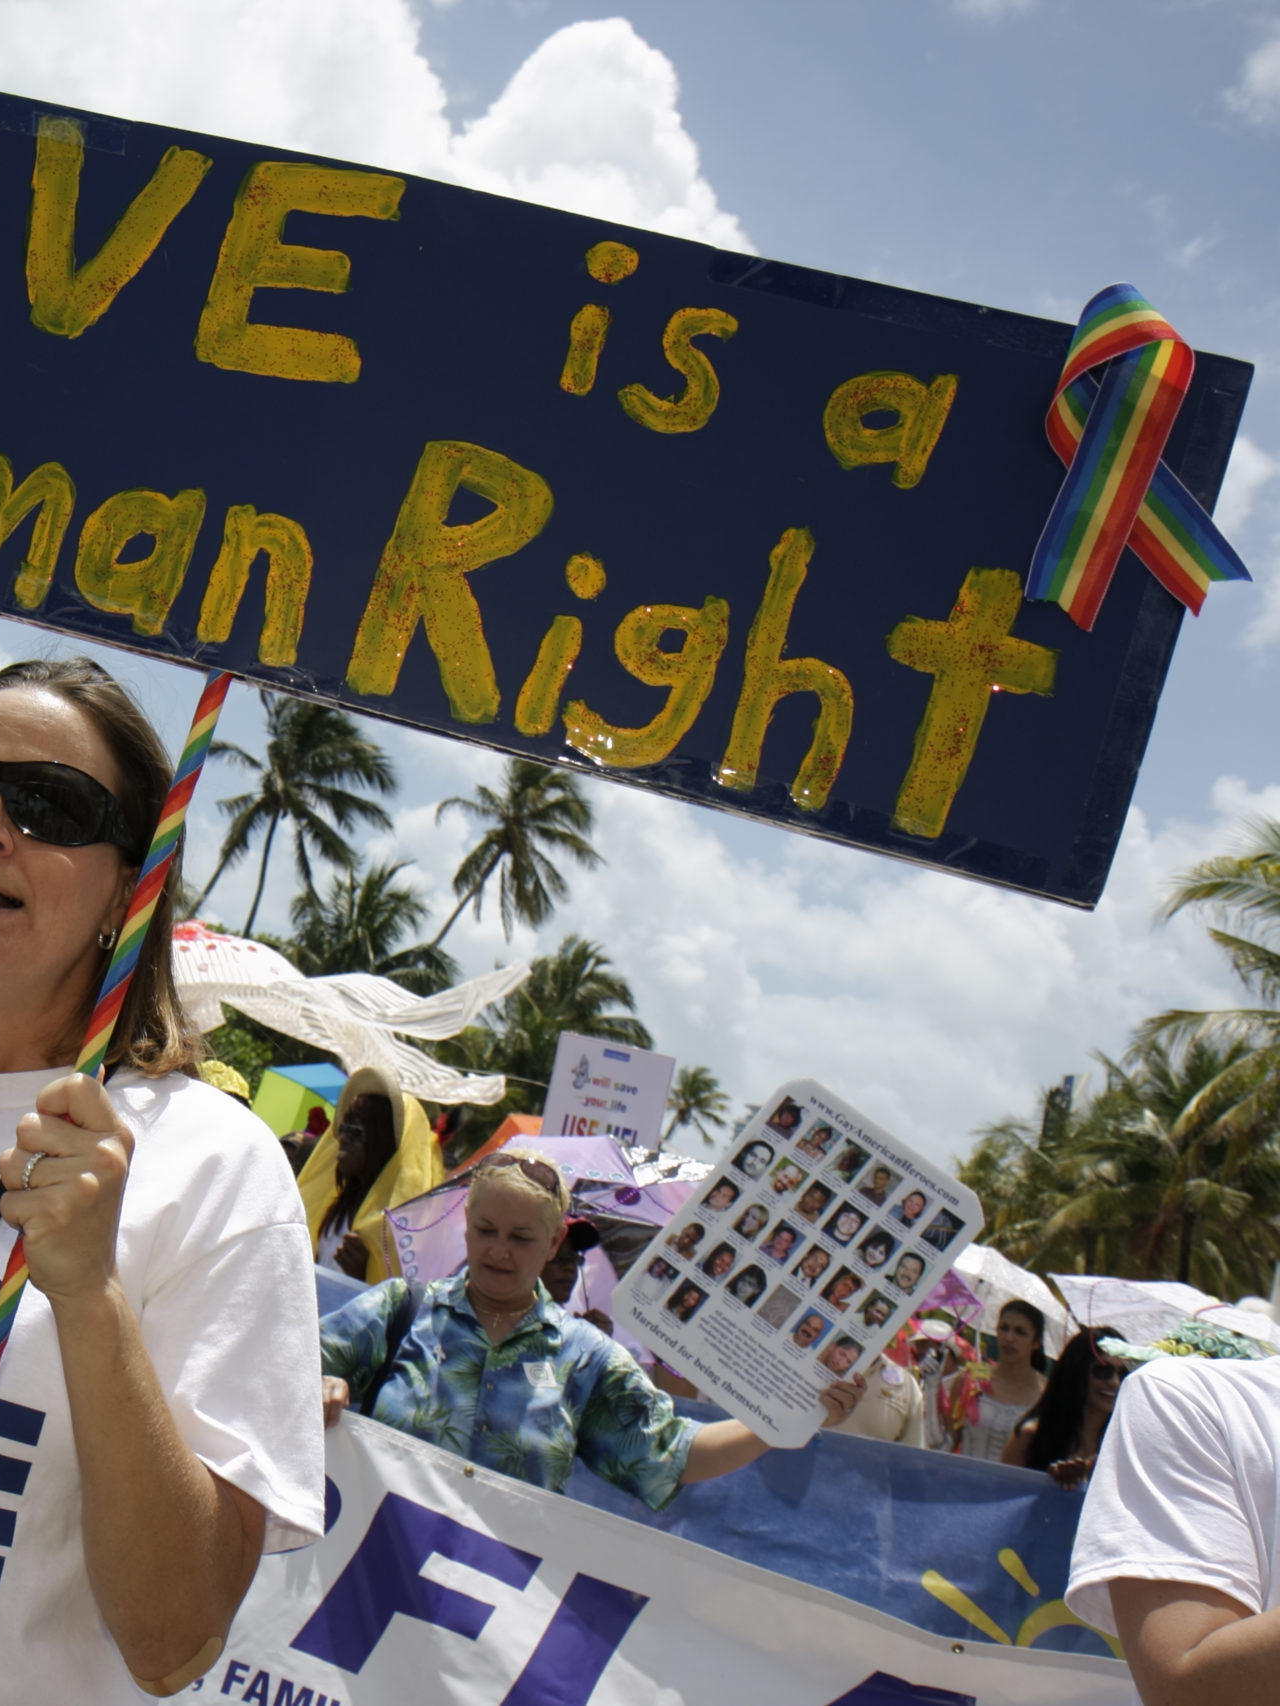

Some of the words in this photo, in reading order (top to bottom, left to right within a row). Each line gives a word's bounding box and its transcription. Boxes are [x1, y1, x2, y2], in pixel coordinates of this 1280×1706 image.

[558, 240, 739, 435] is
[822, 370, 961, 490] a
[345, 439, 1060, 840] Right
[583, 1096, 607, 1108] your
[592, 1077, 612, 1089] will
[613, 1082, 639, 1095] save
[809, 1096, 960, 1207] www.GayAmericanHeroes.com
[630, 1306, 679, 1348] Murdered
[677, 1345, 694, 1360] for
[693, 1357, 721, 1384] being
